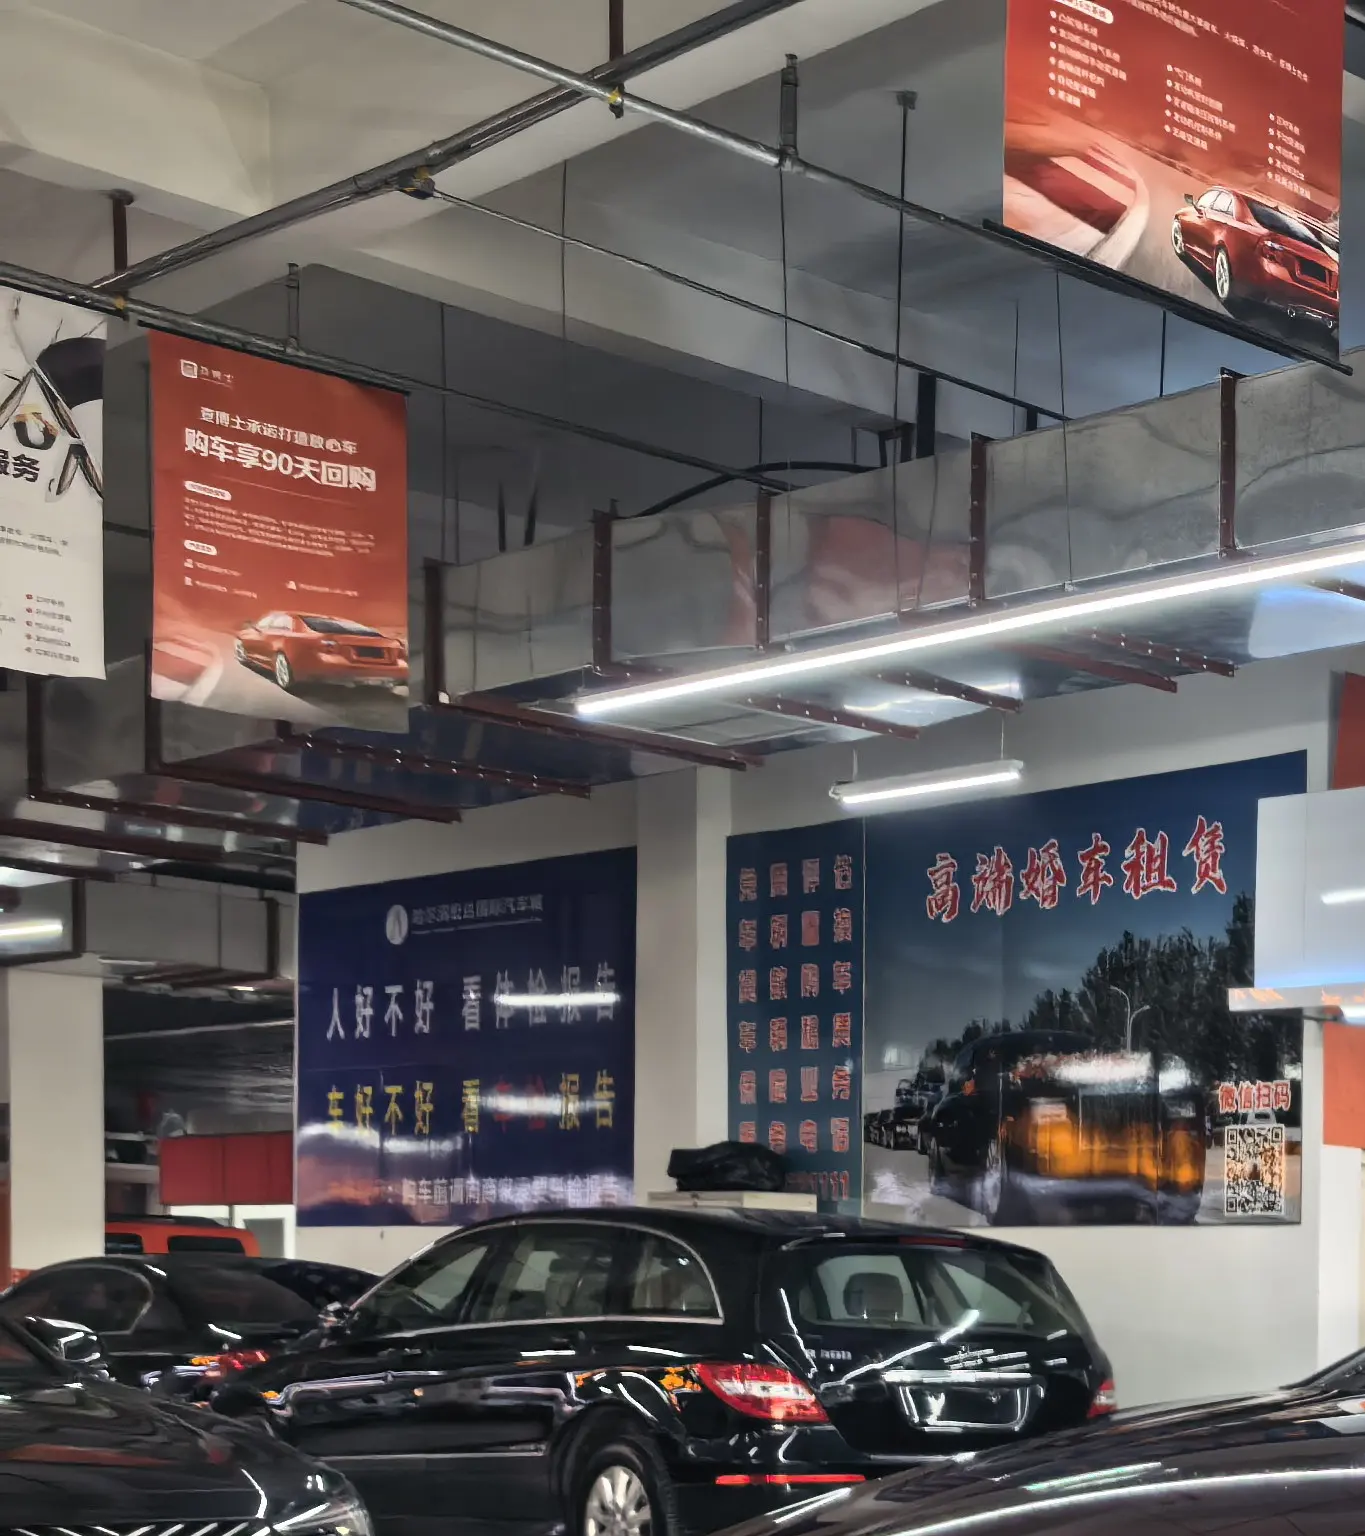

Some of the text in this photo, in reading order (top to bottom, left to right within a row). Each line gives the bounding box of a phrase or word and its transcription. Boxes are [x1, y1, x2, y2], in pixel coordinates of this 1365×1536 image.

[184, 427, 376, 492] 购车享90天回购
[926, 816, 1228, 923] 高端婚车租赁
[326, 979, 434, 1042] 人好不好
[326, 1081, 434, 1136] 车好不好
